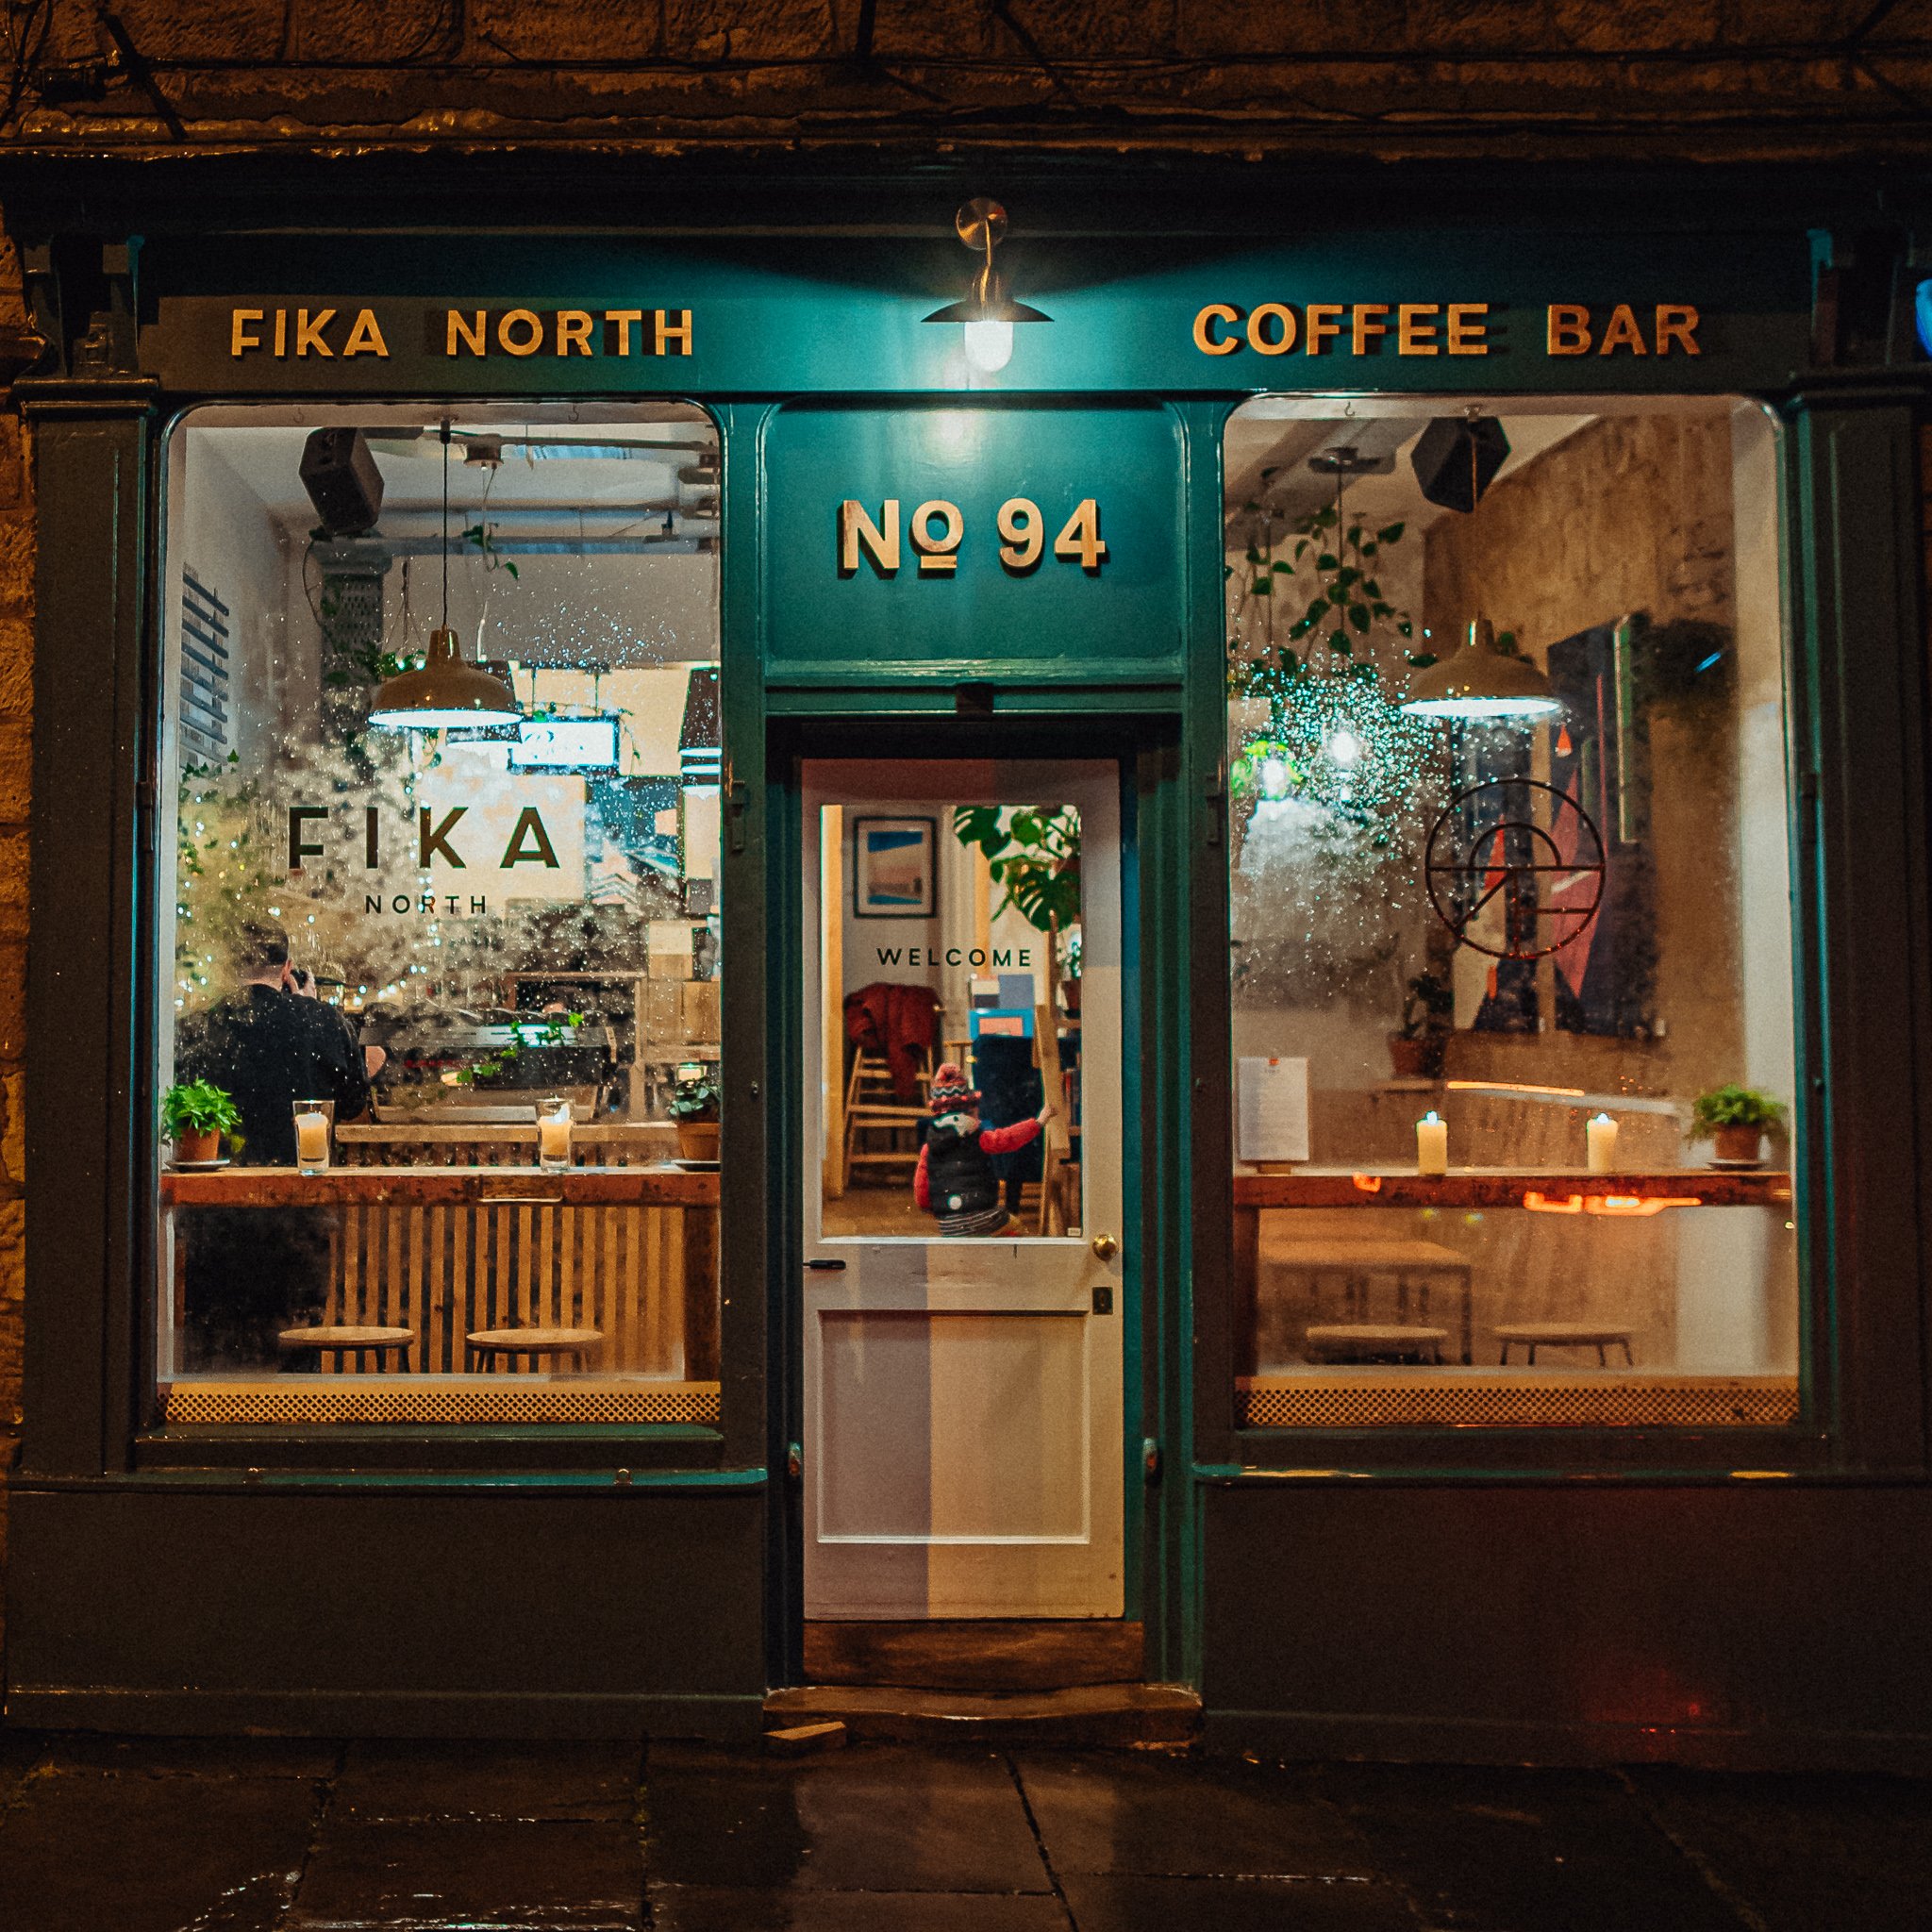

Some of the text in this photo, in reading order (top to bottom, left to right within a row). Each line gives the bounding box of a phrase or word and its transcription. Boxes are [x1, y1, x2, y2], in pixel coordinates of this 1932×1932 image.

[231, 308, 692, 357] FIKA NORTH
[1192, 303, 1701, 356] COFFEE BAR
[997, 497, 1106, 568] 94
[288, 806, 560, 870] FIKA
[365, 894, 486, 914] NORTH
[875, 947, 1032, 968] WELCOME
